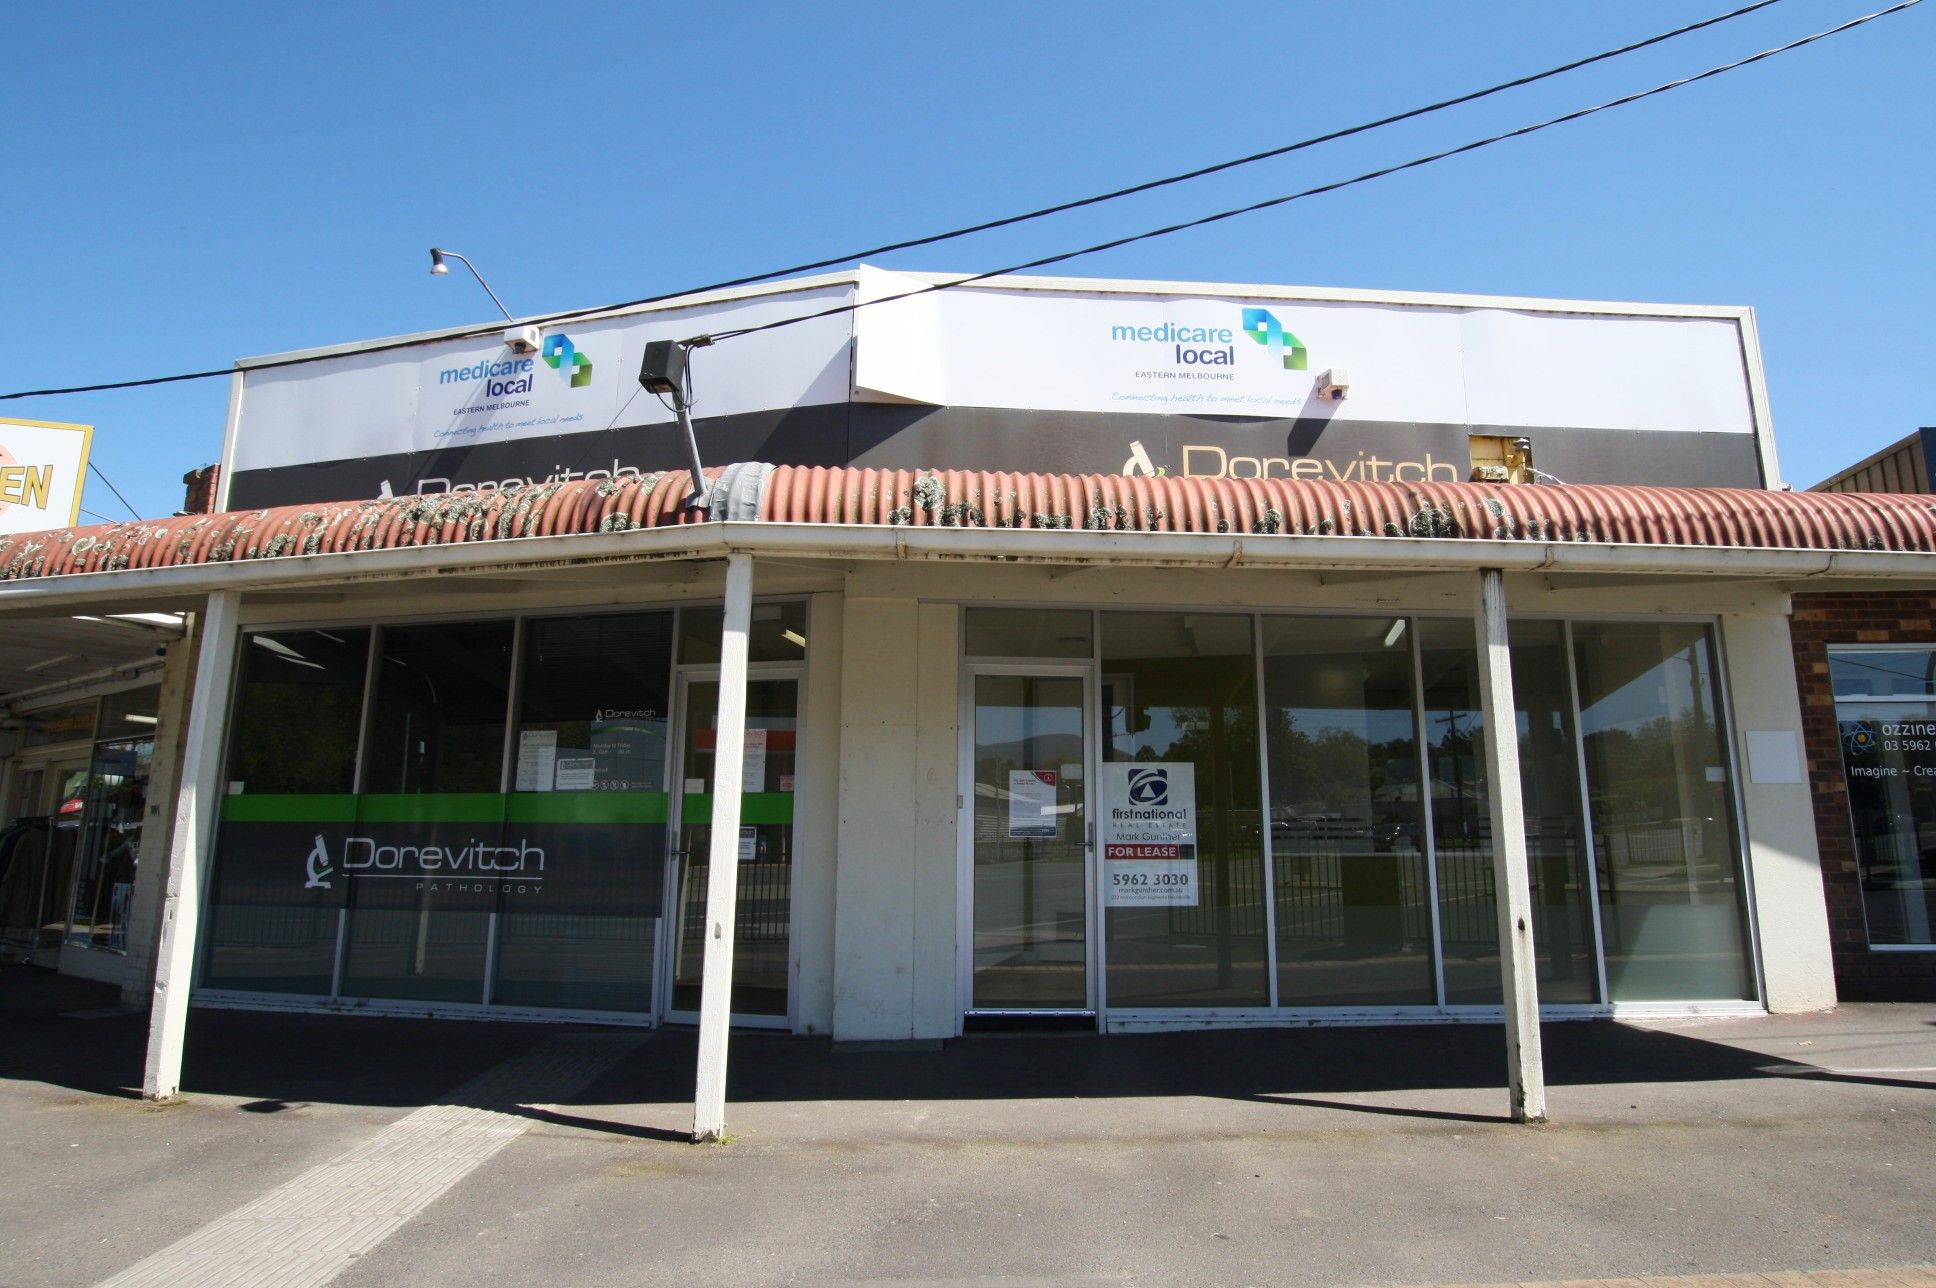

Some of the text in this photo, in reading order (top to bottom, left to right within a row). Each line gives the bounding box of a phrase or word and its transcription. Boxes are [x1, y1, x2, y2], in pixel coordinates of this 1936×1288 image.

[1111, 322, 1233, 343] medicare
[1175, 344, 1235, 365] local
[439, 358, 534, 384] medicare
[1135, 370, 1235, 381] EASTERN MELBOURNE
[486, 373, 533, 398] local
[1111, 391, 1302, 406] Connecting health to meet local needs
[453, 400, 530, 416] EASTERN MELBOURNE
[433, 412, 584, 438] Connecting health to meet local needs
[1182, 444, 1458, 483] Dorevitch
[605, 708, 656, 718] Dorevitch
[1882, 723, 1936, 736] ozzine
[1884, 740, 1899, 751] 03
[1902, 740, 1931, 751] 5962
[1851, 765, 1898, 779] Imagine
[1116, 832, 1140, 841] Mark
[343, 837, 545, 871] Dorevitch
[1108, 847, 1176, 857] FOR LEASE
[1113, 873, 1189, 886] 5962 3030
[416, 883, 542, 894] PATHOLOGY
